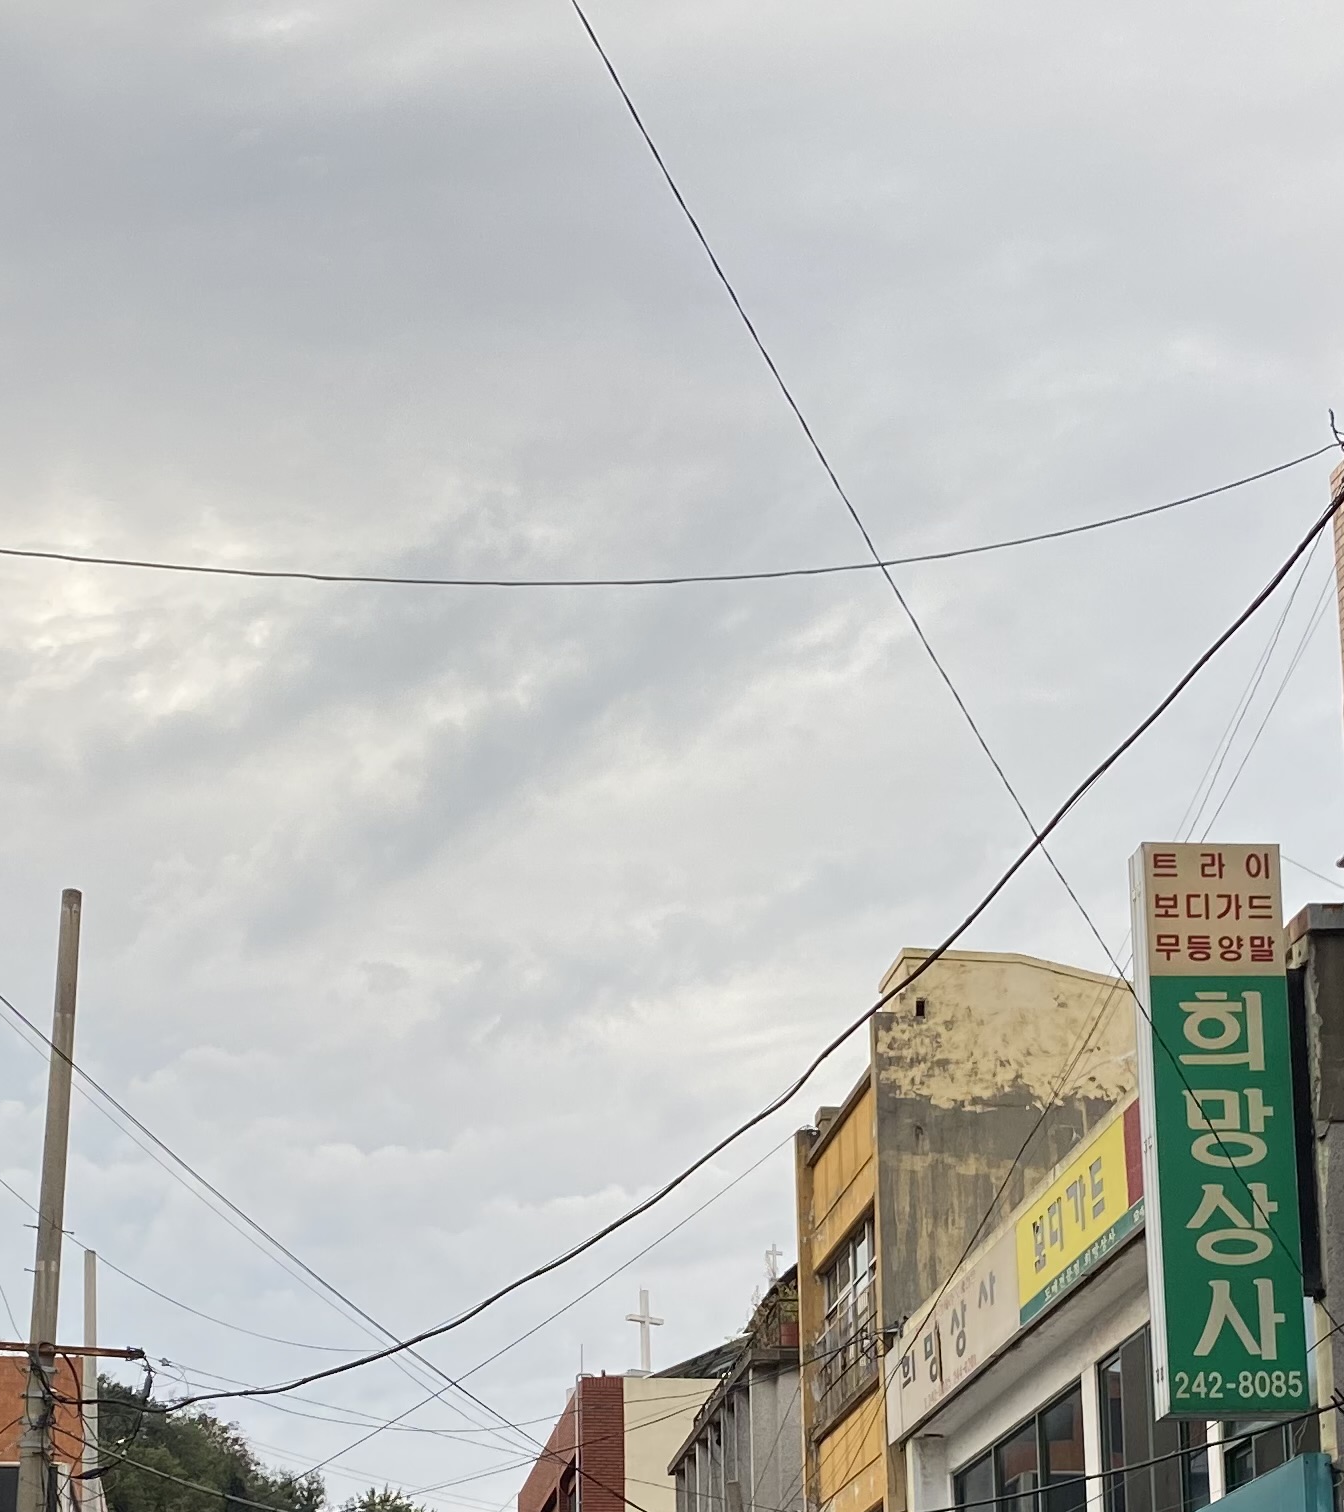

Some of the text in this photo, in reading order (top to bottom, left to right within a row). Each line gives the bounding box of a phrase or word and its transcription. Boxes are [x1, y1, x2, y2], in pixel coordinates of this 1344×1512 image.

[1152, 851, 1271, 880] 트라이
[1154, 891, 1275, 921] 보디가드
[1155, 933, 1276, 963] 무등양말
[1177, 989, 1287, 1361] 희망상사
[1032, 1156, 1105, 1275] 보디가드
[1174, 1369, 1304, 1400] 242-8085
